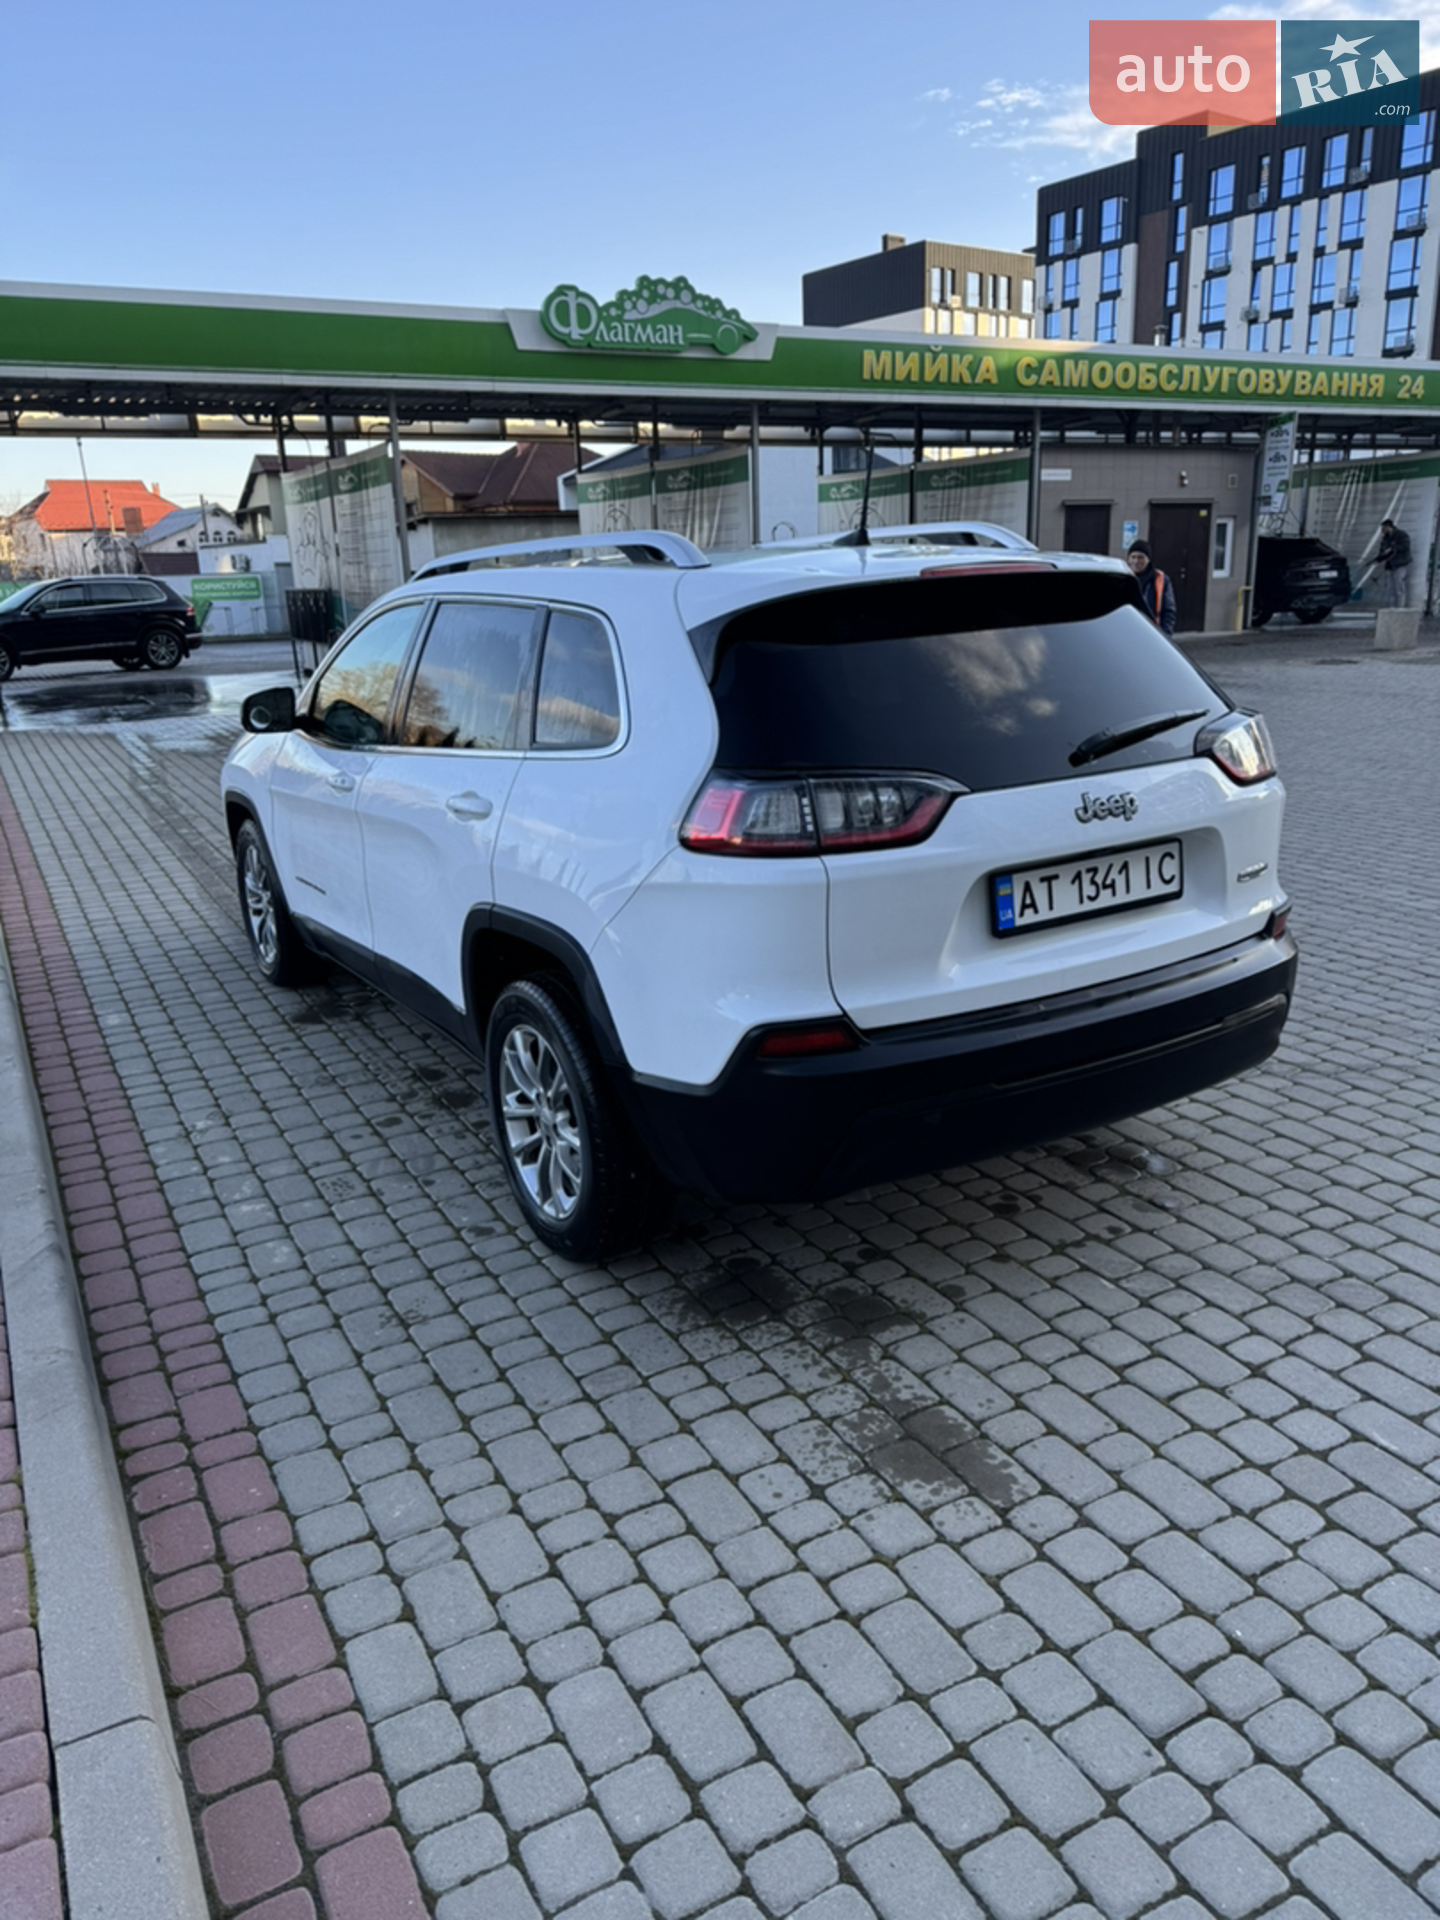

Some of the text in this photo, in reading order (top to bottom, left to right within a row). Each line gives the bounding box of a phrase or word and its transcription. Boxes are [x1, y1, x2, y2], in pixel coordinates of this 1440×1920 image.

[550, 290, 685, 345] Флагман
[862, 345, 1425, 399] МИЙКА САМООБСЛУГОВУВАННЯ 24
[1075, 792, 1139, 823] Jeep
[1019, 851, 1176, 918] AT 1341 IC
[999, 908, 1014, 921] UA
